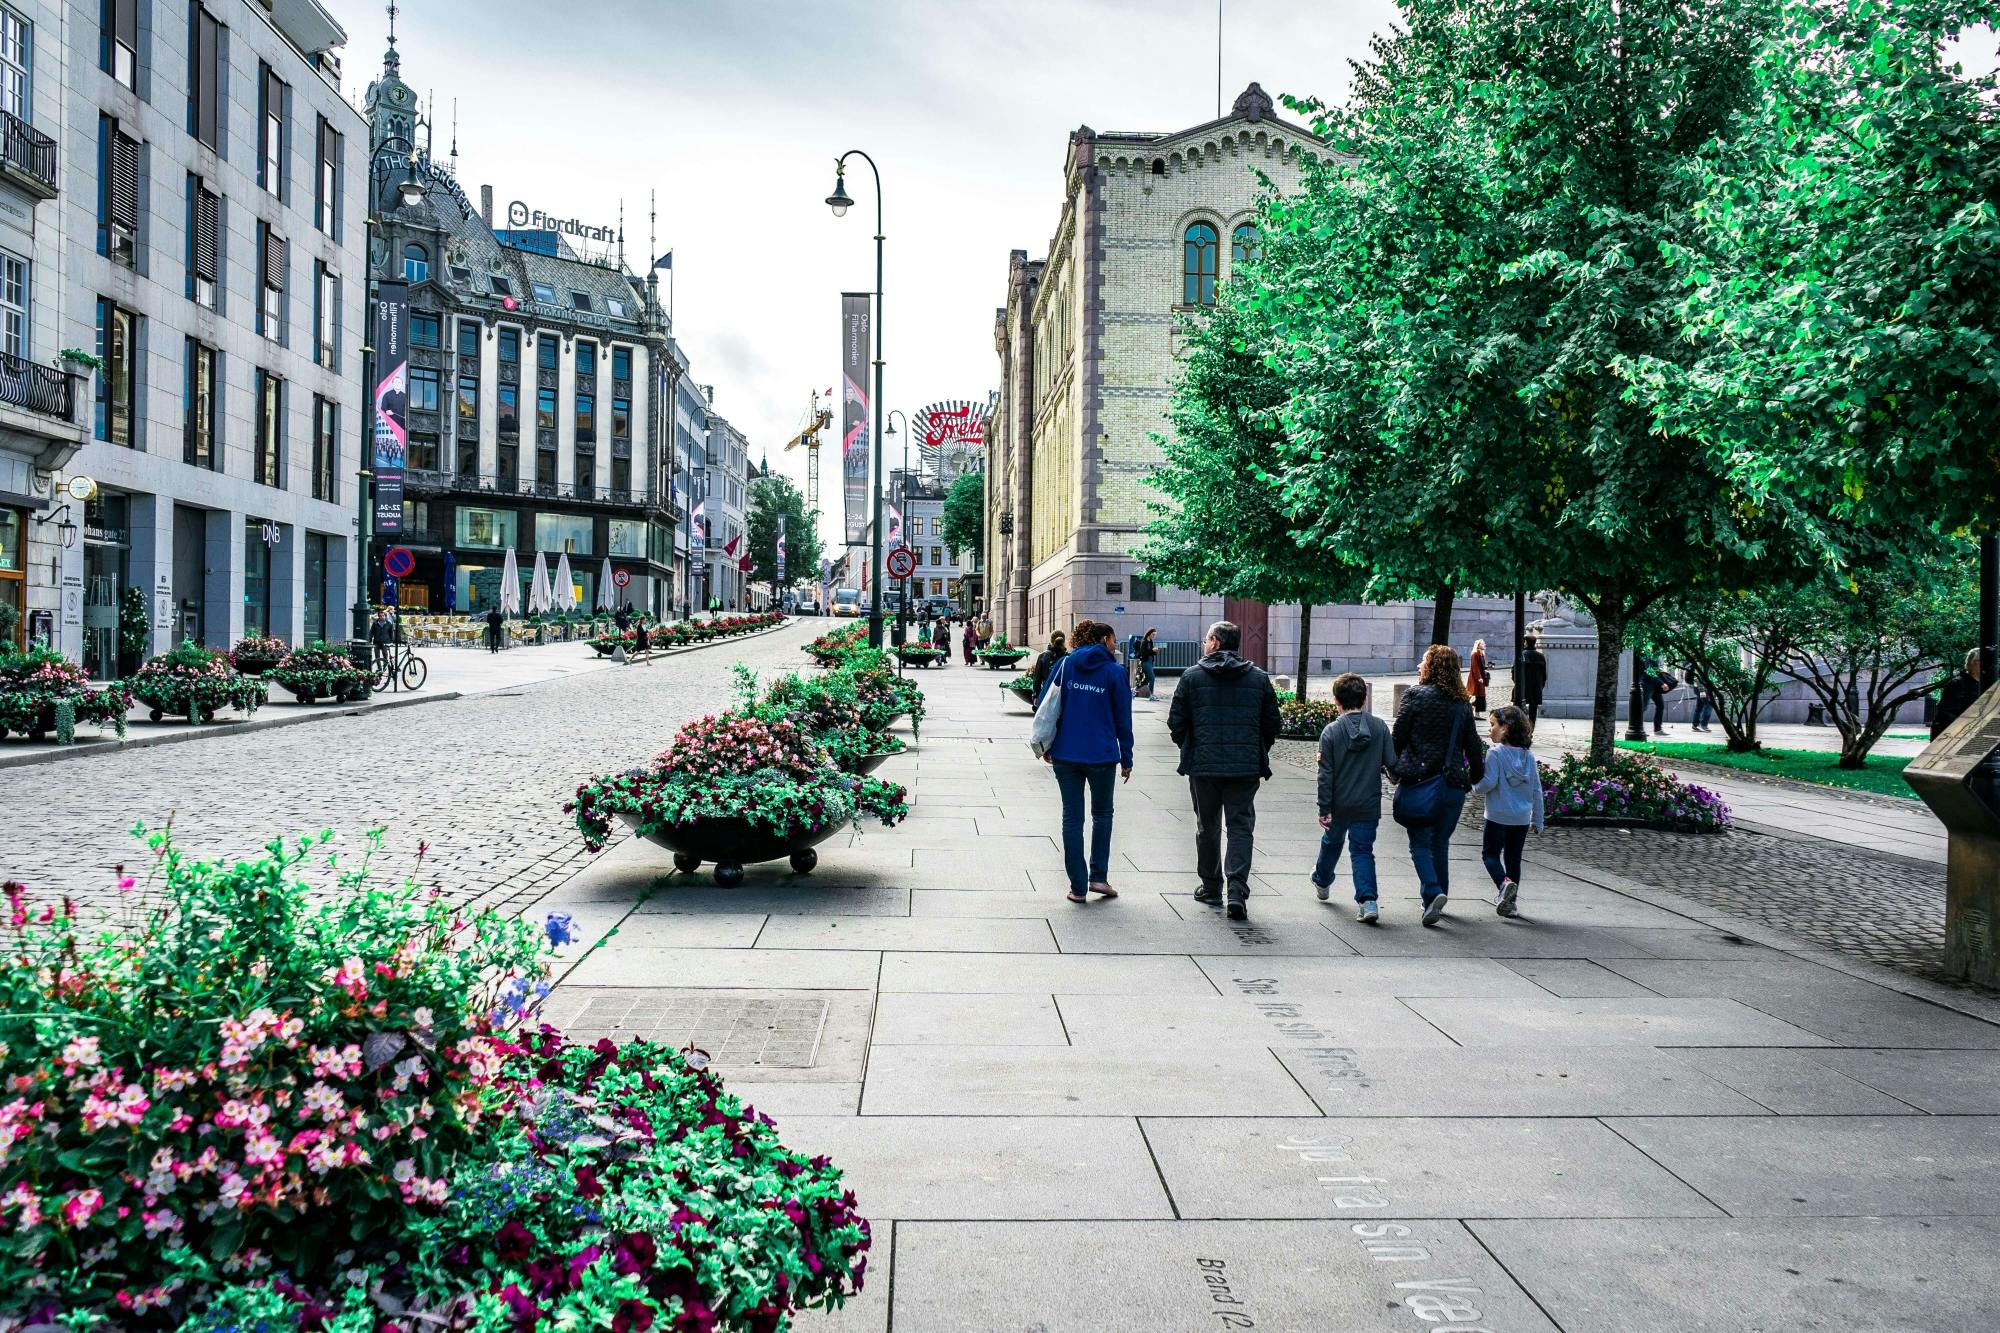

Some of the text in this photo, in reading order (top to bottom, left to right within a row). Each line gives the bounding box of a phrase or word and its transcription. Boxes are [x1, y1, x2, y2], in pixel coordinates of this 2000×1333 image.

[428, 165, 475, 221] GRUPPEN
[532, 210, 615, 243] Fjordkraft
[851, 313, 860, 366] Filharmonien
[860, 313, 869, 333] Oslo
[262, 520, 281, 549] DNB
[1073, 682, 1105, 694] OURWAY
[1231, 978, 1280, 995] Sne
[1254, 1002, 1304, 1018] fra
[1273, 1022, 1333, 1040] sin
[1314, 1168, 1391, 1208] fra
[1351, 1222, 1442, 1261] sin
[1196, 1258, 1245, 1305] Brand
[1391, 1275, 1498, 1333] Væ
